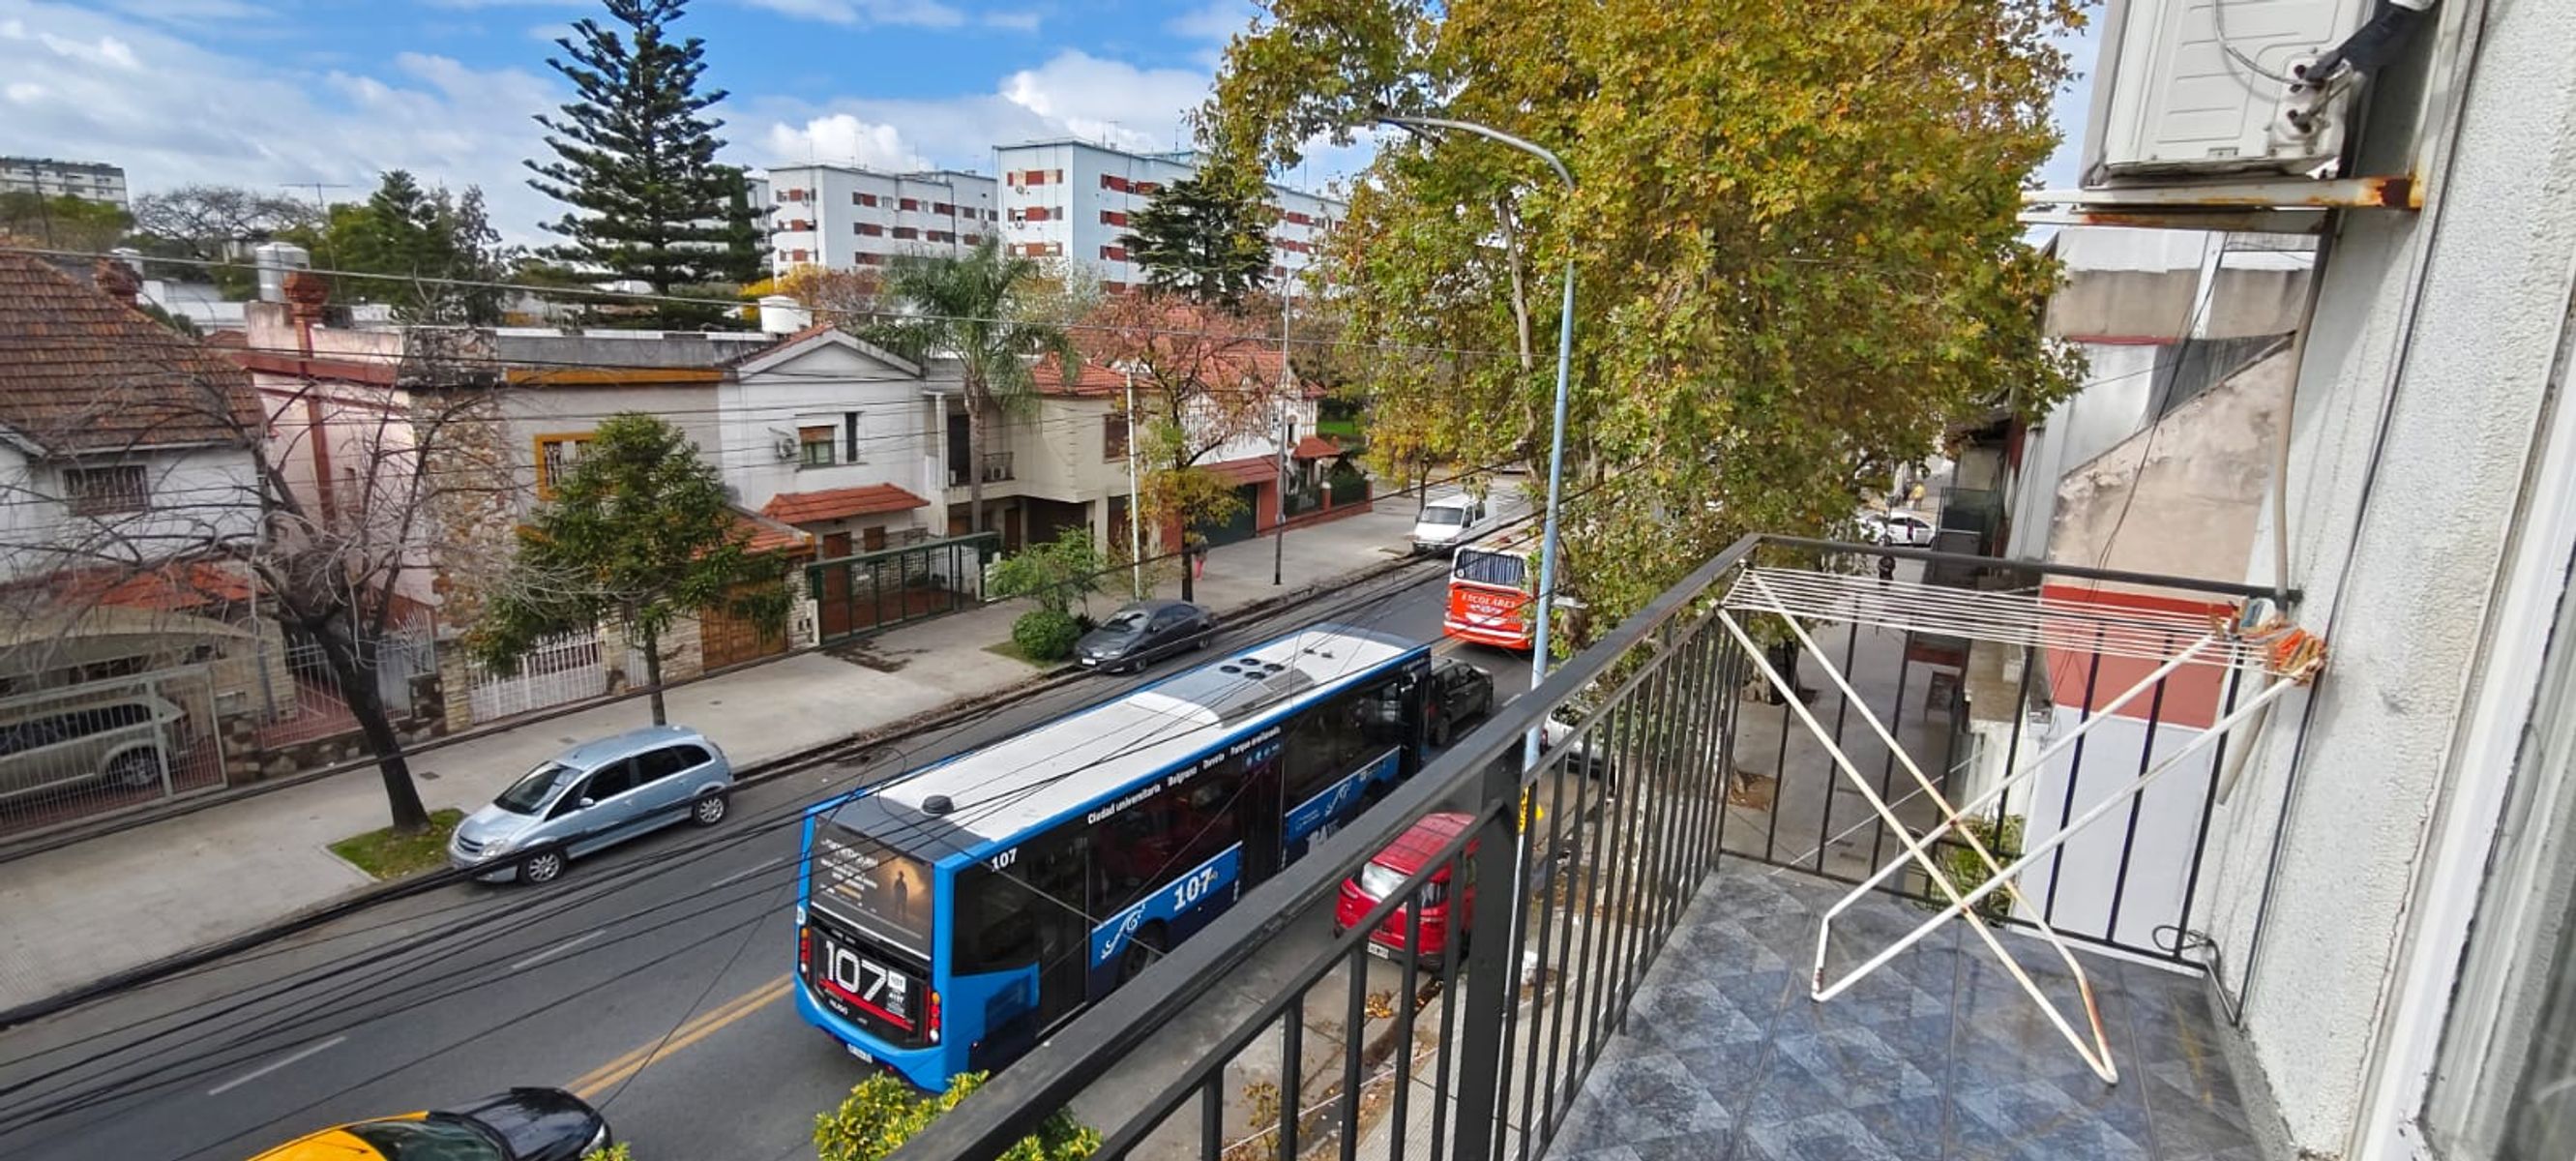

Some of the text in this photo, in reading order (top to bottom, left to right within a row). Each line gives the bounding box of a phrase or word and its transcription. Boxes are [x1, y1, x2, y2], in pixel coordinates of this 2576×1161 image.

[1087, 803, 1115, 824] Ciudad
[992, 847, 1019, 873] 107
[1173, 867, 1213, 911] 107
[825, 940, 887, 1001] 107
